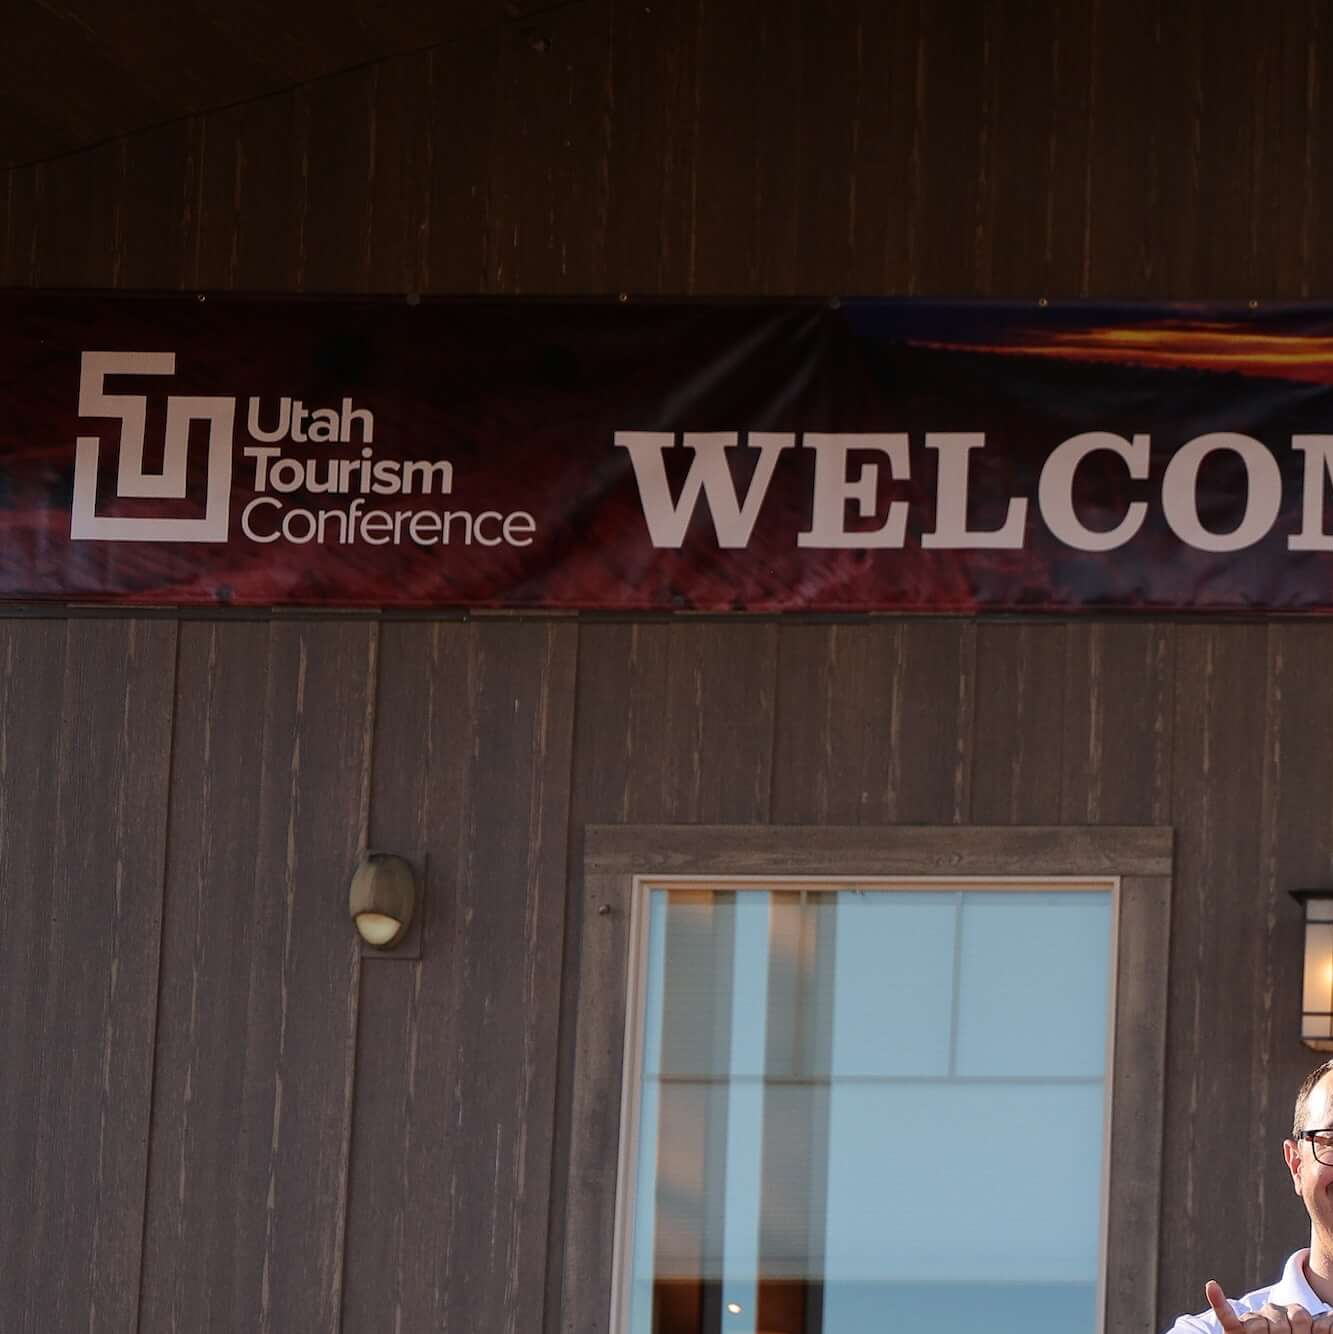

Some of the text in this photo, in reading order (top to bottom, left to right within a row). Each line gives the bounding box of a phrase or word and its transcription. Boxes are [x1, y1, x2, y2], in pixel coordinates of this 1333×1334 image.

[247, 396, 374, 444] Utah
[243, 446, 453, 494] Tourism
[241, 496, 537, 547] Conference
